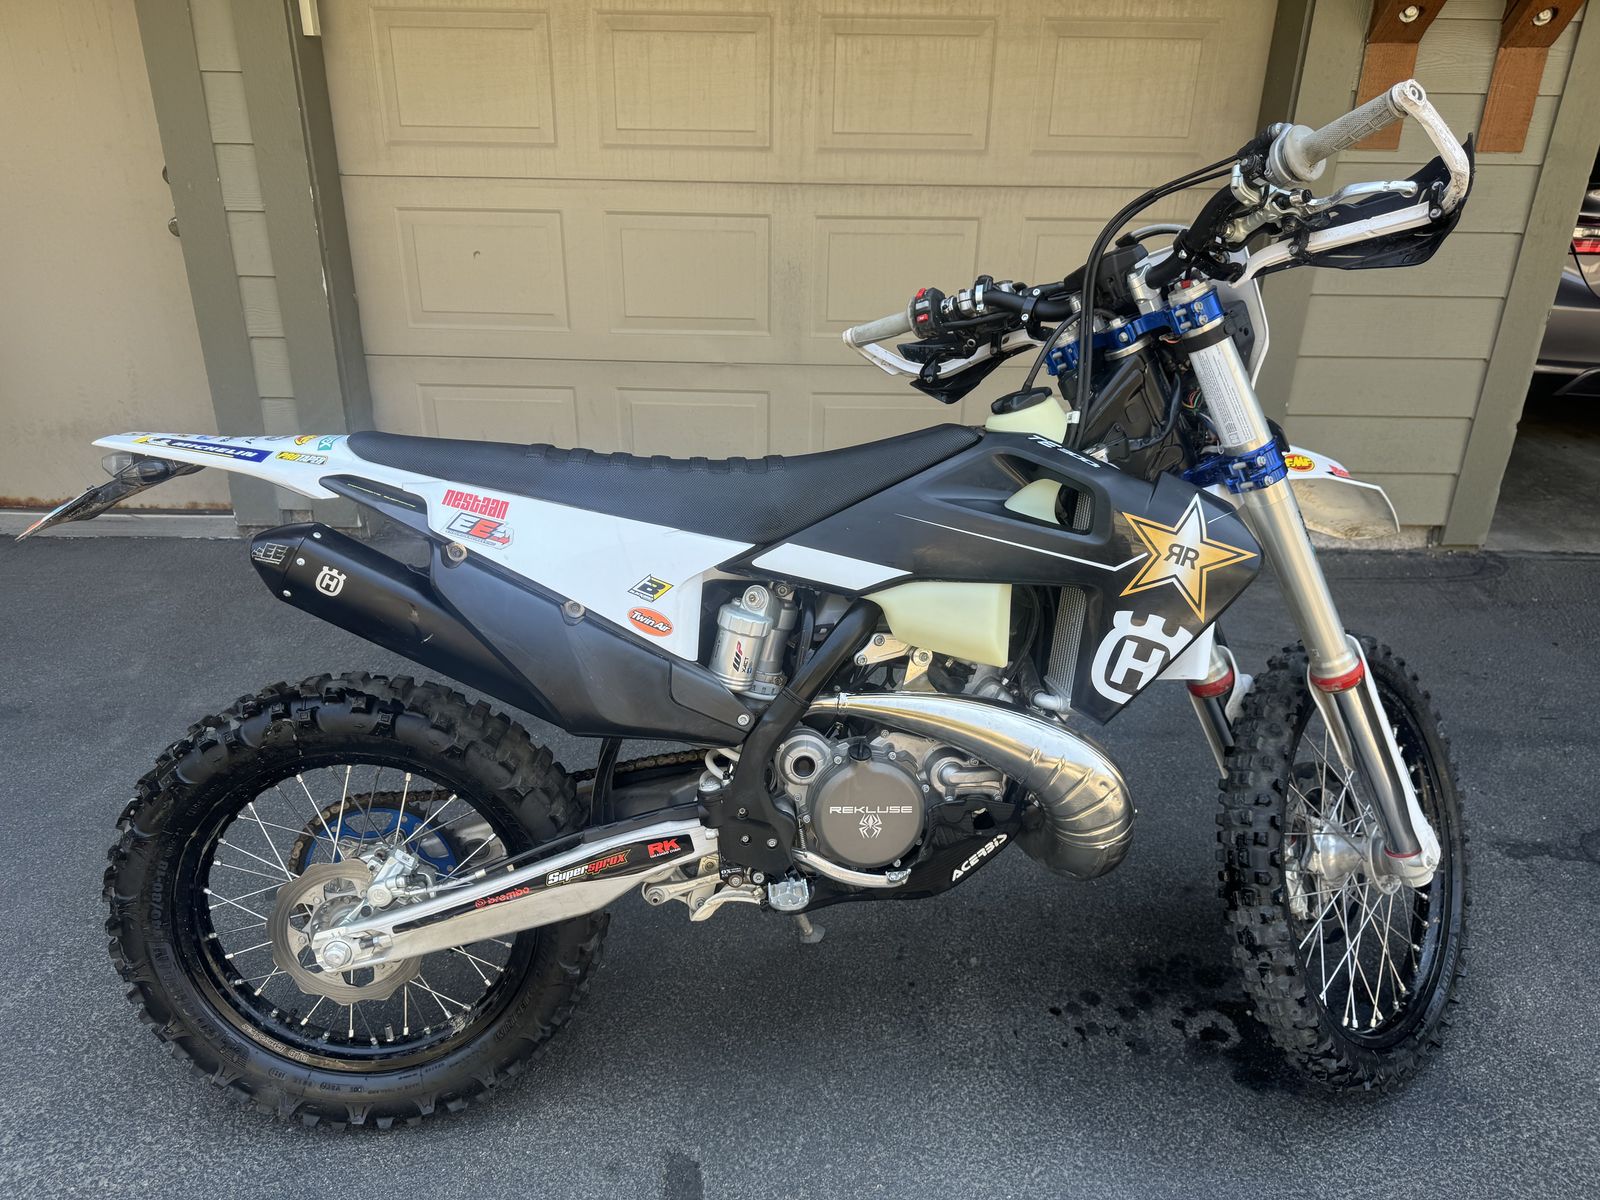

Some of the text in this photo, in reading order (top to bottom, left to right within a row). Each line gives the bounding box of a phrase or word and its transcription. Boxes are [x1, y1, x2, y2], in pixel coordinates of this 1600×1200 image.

[170, 441, 259, 458] MICHELIN
[631, 610, 673, 632] Twin Air
[829, 805, 913, 814] REKLUSE
[648, 838, 681, 857] RK
[951, 832, 1008, 882] ACERBIS
[487, 886, 531, 905] brembo
